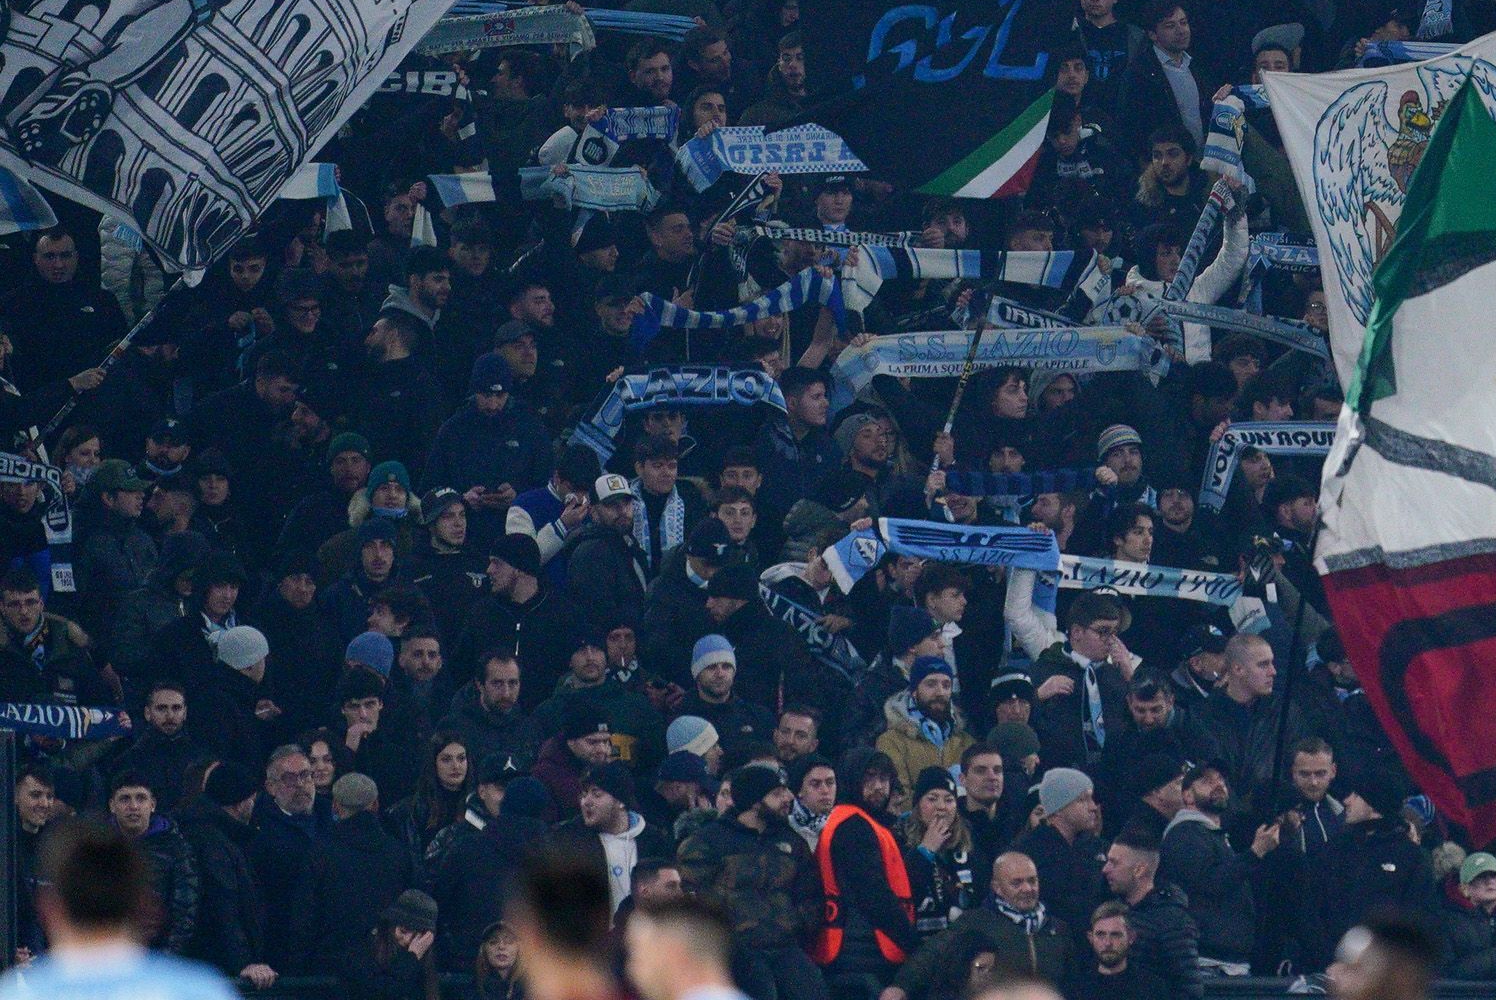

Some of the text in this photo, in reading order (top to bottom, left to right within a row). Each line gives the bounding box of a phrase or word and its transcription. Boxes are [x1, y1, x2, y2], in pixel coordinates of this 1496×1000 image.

[904, 364, 939, 375] PRIMA
[1034, 357, 1090, 370] CAPITALE
[1211, 433, 1240, 487] VOLA
[1070, 562, 1241, 599] LAZIO 1900
